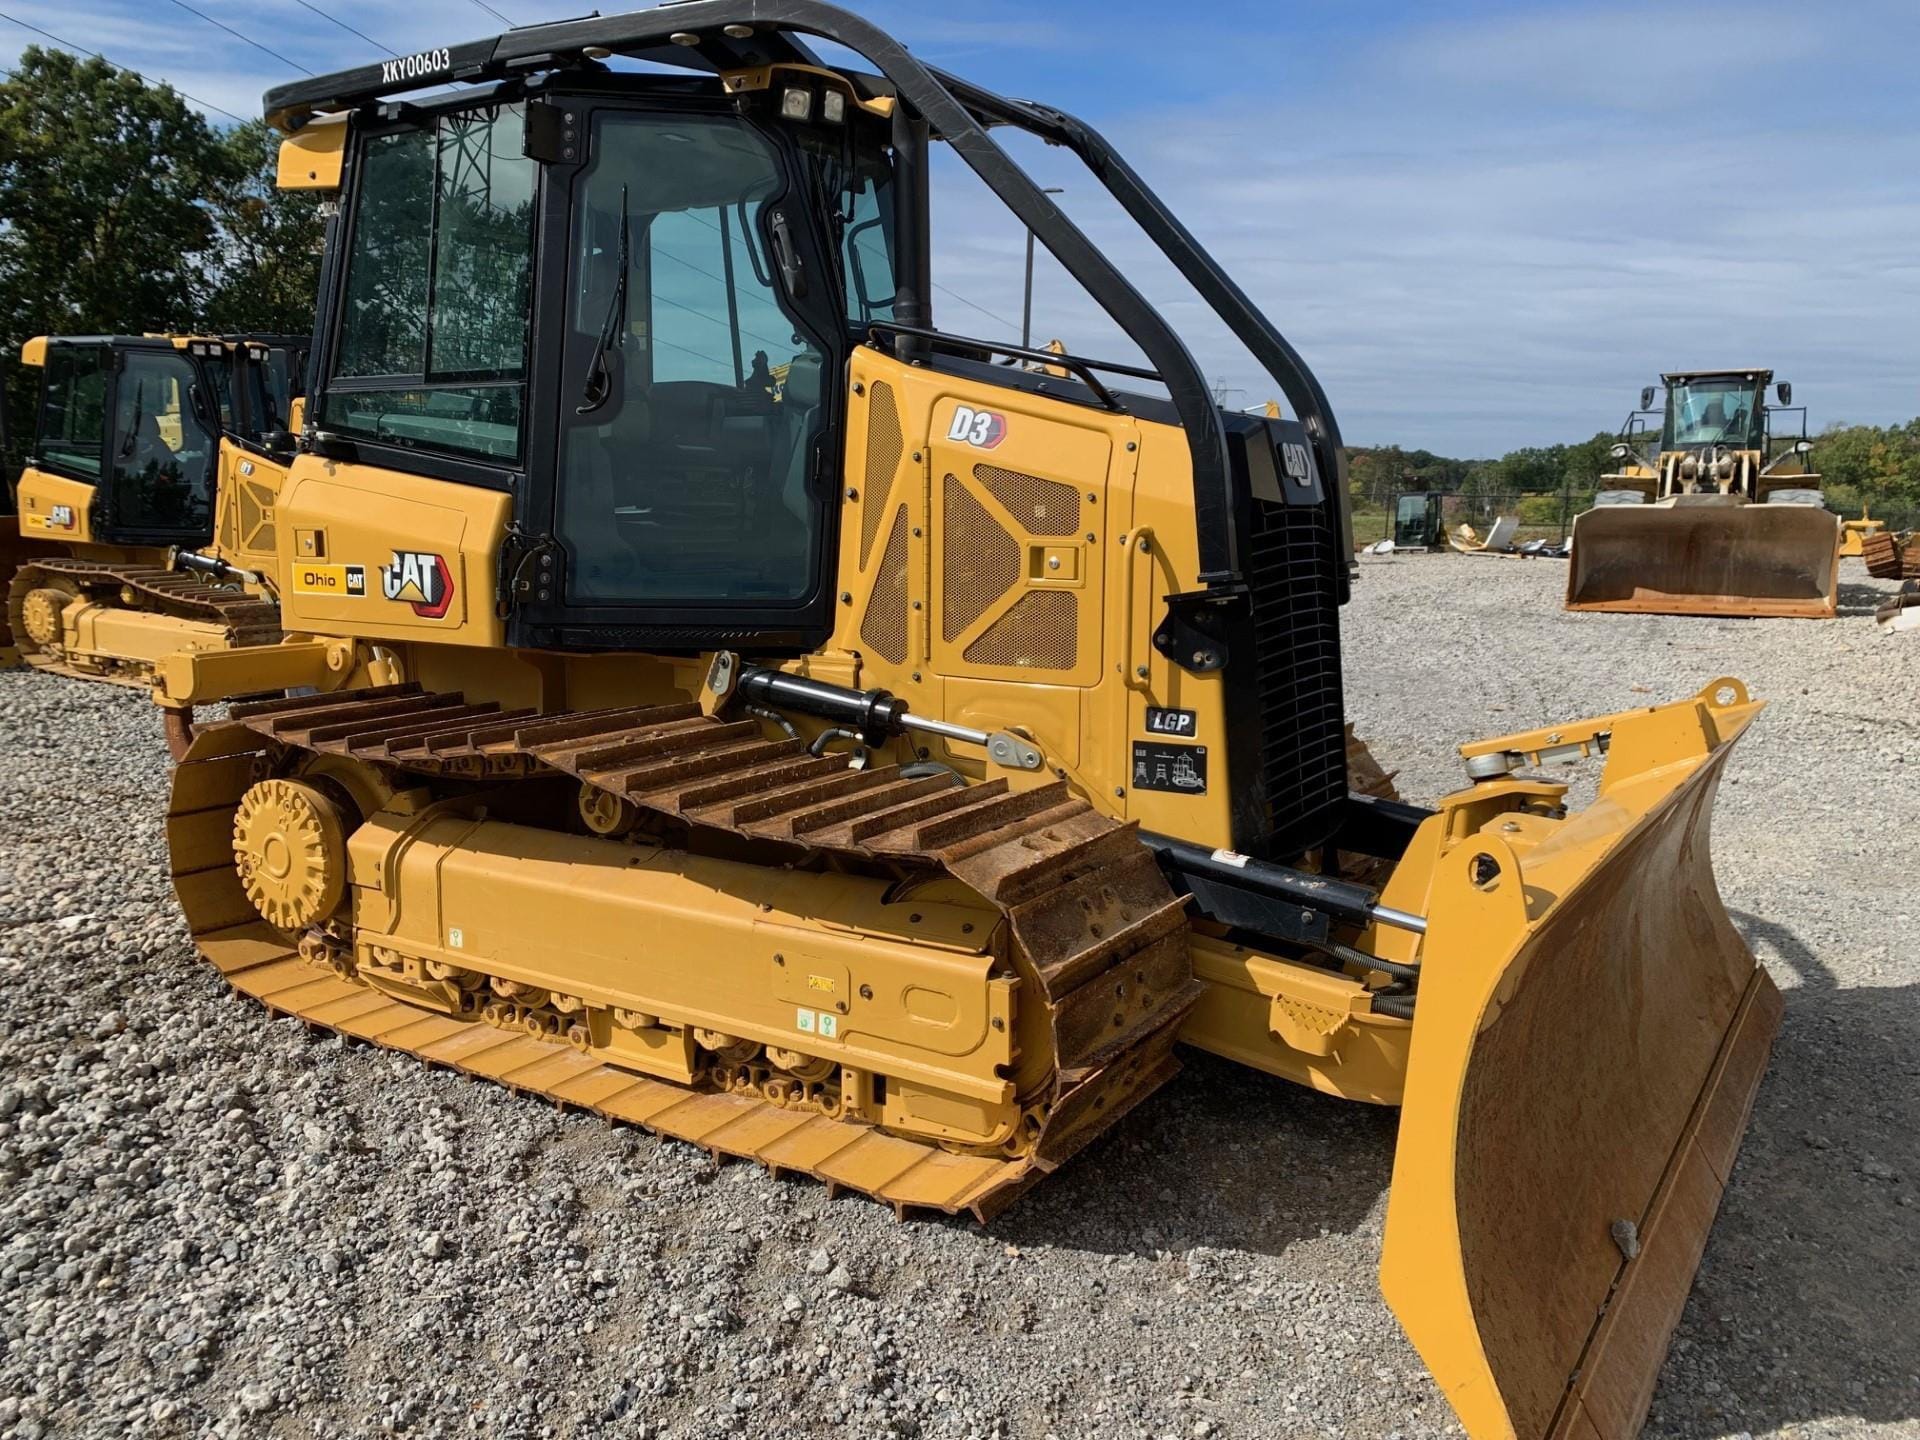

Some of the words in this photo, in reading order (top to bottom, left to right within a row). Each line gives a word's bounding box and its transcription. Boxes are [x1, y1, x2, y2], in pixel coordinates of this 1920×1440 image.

[382, 48, 450, 84] XKY00603
[949, 406, 992, 446] D3
[1282, 442, 1306, 477] CAT
[304, 572, 336, 587] Ohio
[347, 573, 364, 588] CAT
[383, 551, 436, 603] CAT
[1153, 711, 1190, 731] LGP
